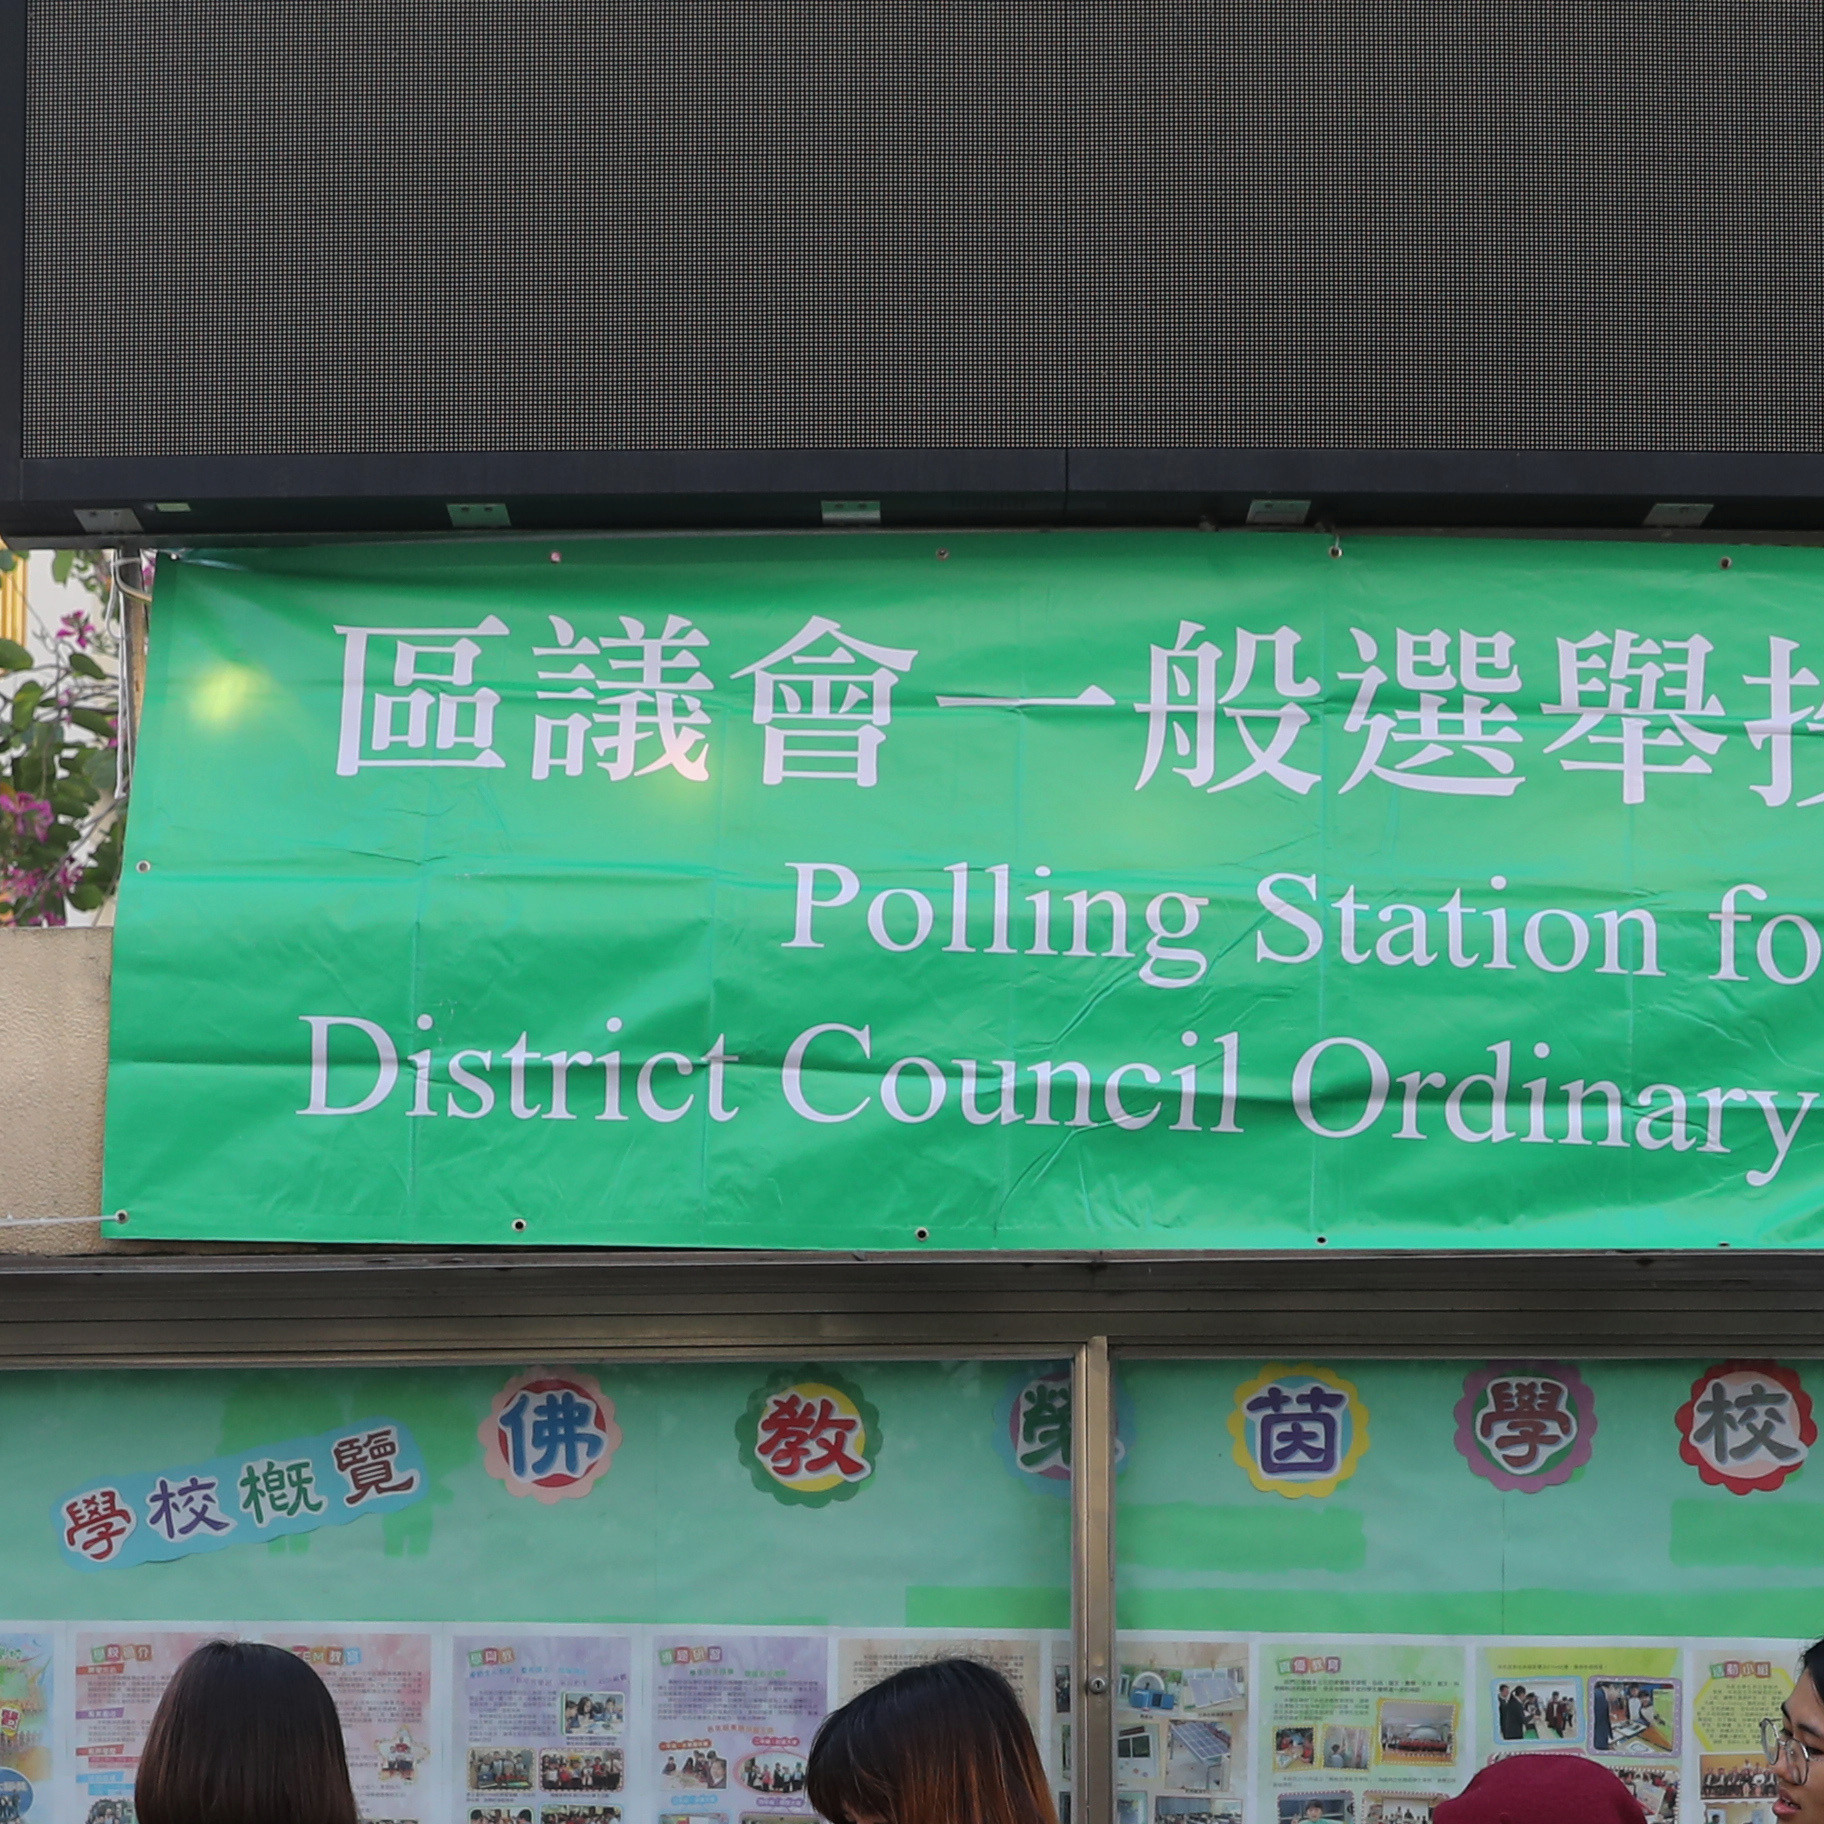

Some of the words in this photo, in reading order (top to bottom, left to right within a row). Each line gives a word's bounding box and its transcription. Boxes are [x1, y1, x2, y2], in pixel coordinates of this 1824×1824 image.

[779, 860, 1211, 990] Polling
[1255, 871, 1668, 978] Station
[294, 1012, 739, 1123] District
[780, 1022, 1245, 1133] Council
[1290, 1035, 1821, 1188] Ordinary
[65, 1427, 415, 1562] 學校概覽
